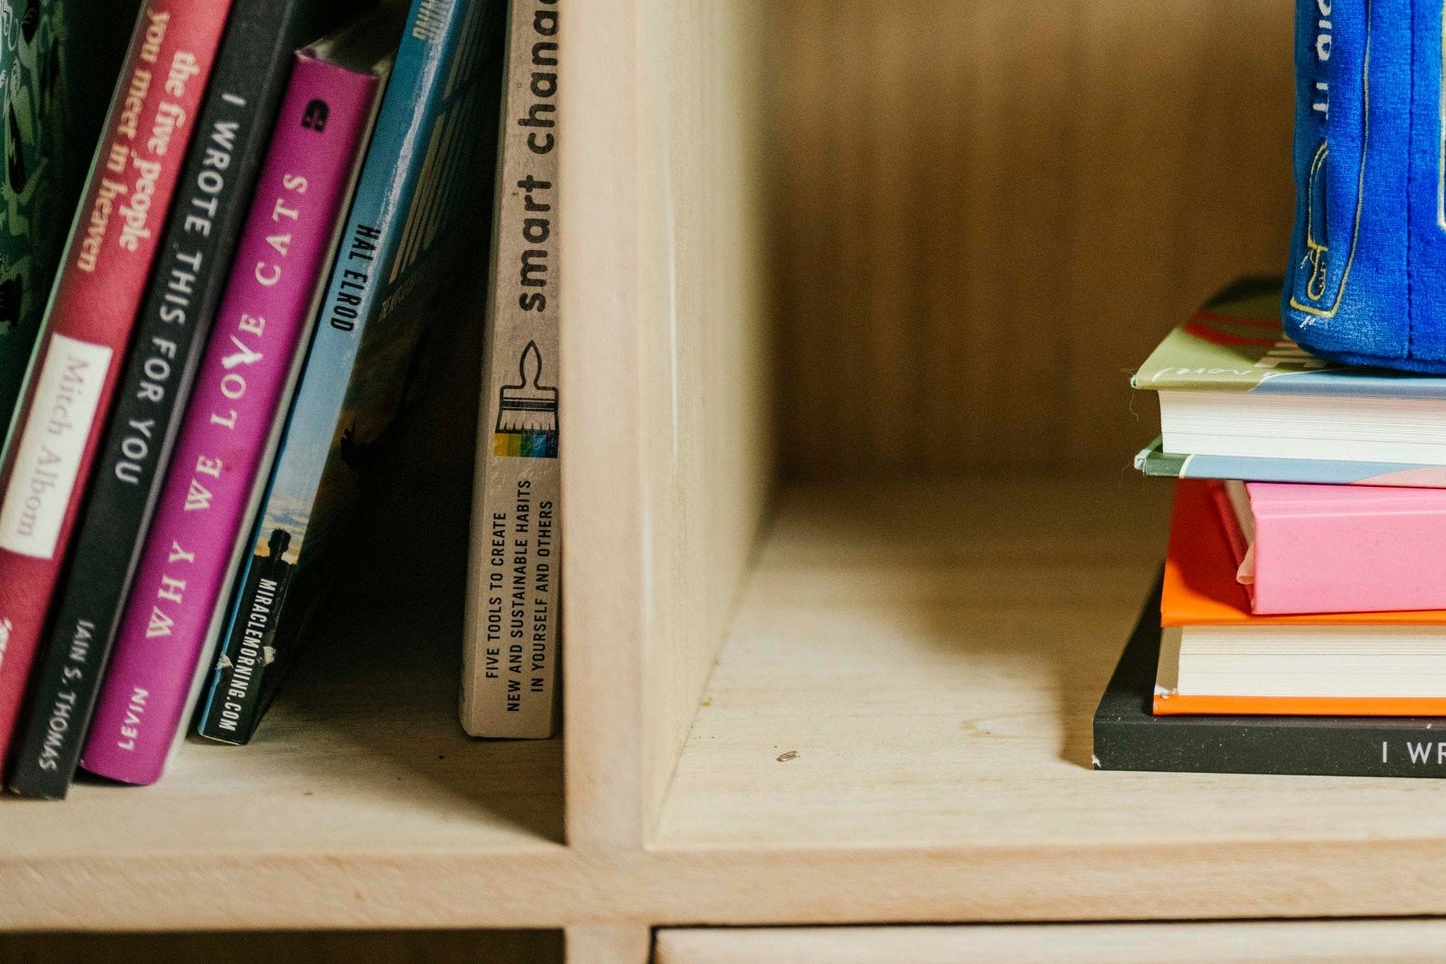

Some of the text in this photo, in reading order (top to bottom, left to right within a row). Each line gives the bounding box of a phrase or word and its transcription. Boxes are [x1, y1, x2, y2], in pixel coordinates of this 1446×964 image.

[77, 9, 171, 273] you meet in heaven
[118, 50, 201, 253] the five people
[1312, 82, 1329, 120] IT
[114, 92, 247, 485] I WROTE THIS FOR YOU
[330, 224, 381, 332] HAL ELROD
[517, 175, 552, 313] smart
[18, 356, 90, 537] Mitch Albom
[145, 172, 309, 640] WHY WE LOVE CATS
[218, 577, 278, 732] MIRACLEMORNING.COM
[486, 512, 507, 679] FIVE TOOLS TO CREATE
[507, 479, 532, 712] NEW AND SUSTAINABLE HABITS
[531, 500, 553, 693] IN YOURSELF AND OTHERS
[38, 619, 95, 772] IAIN S. THOMAS
[117, 686, 149, 751] LEVIN
[1381, 741, 1388, 763] I
